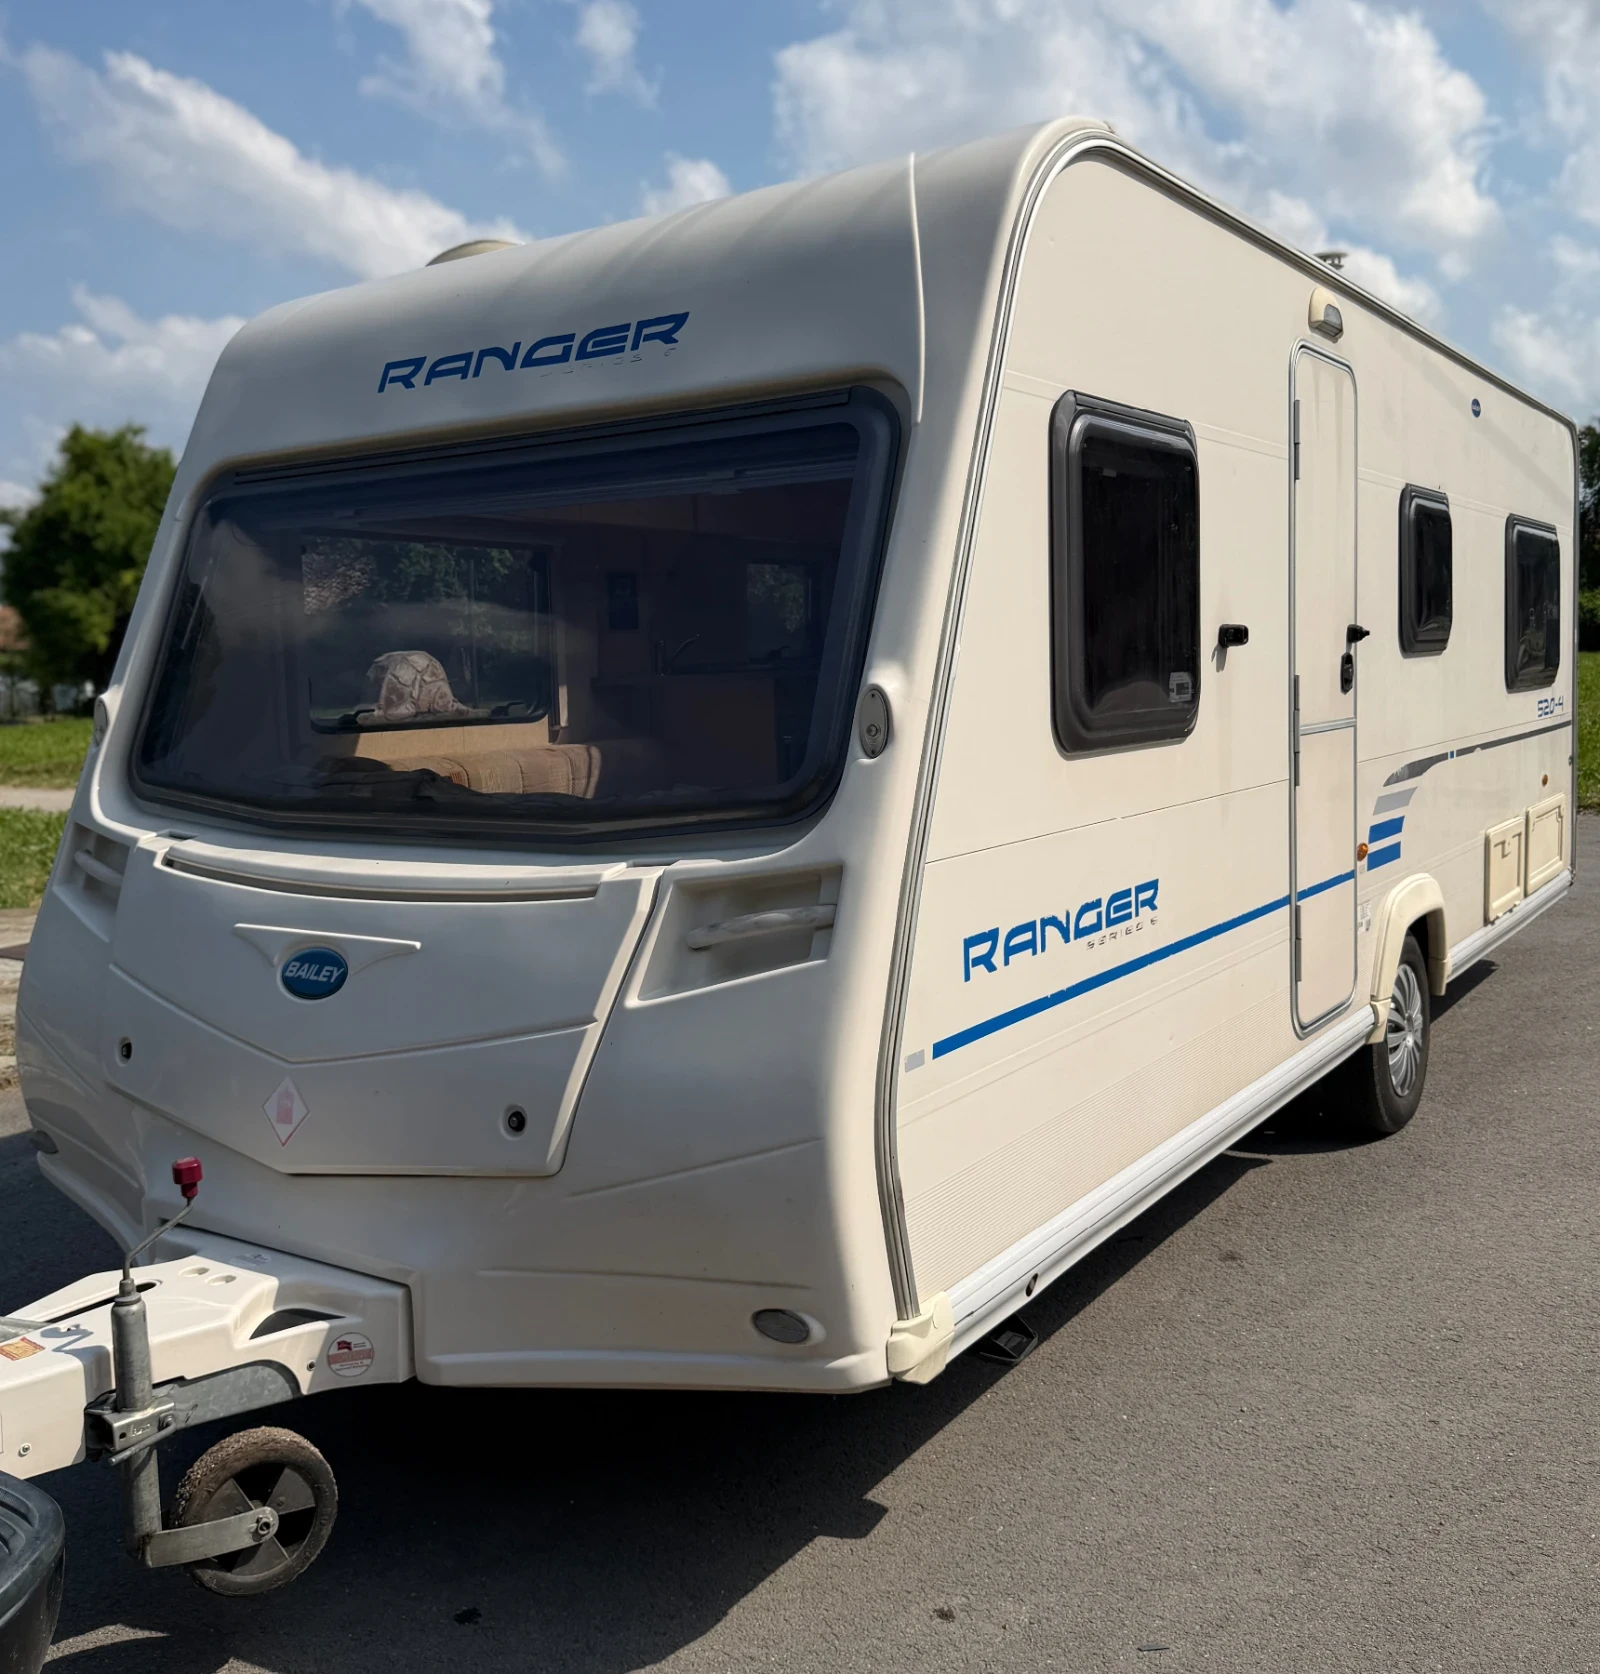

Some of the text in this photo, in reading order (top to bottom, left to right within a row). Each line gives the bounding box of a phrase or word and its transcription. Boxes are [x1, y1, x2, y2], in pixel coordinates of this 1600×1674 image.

[377, 311, 690, 394] RANGER
[1537, 695, 1564, 718] 520-4
[963, 878, 1159, 983] RANGER
[1086, 921, 1144, 951] SERIES
[284, 961, 345, 983] BAILEY
